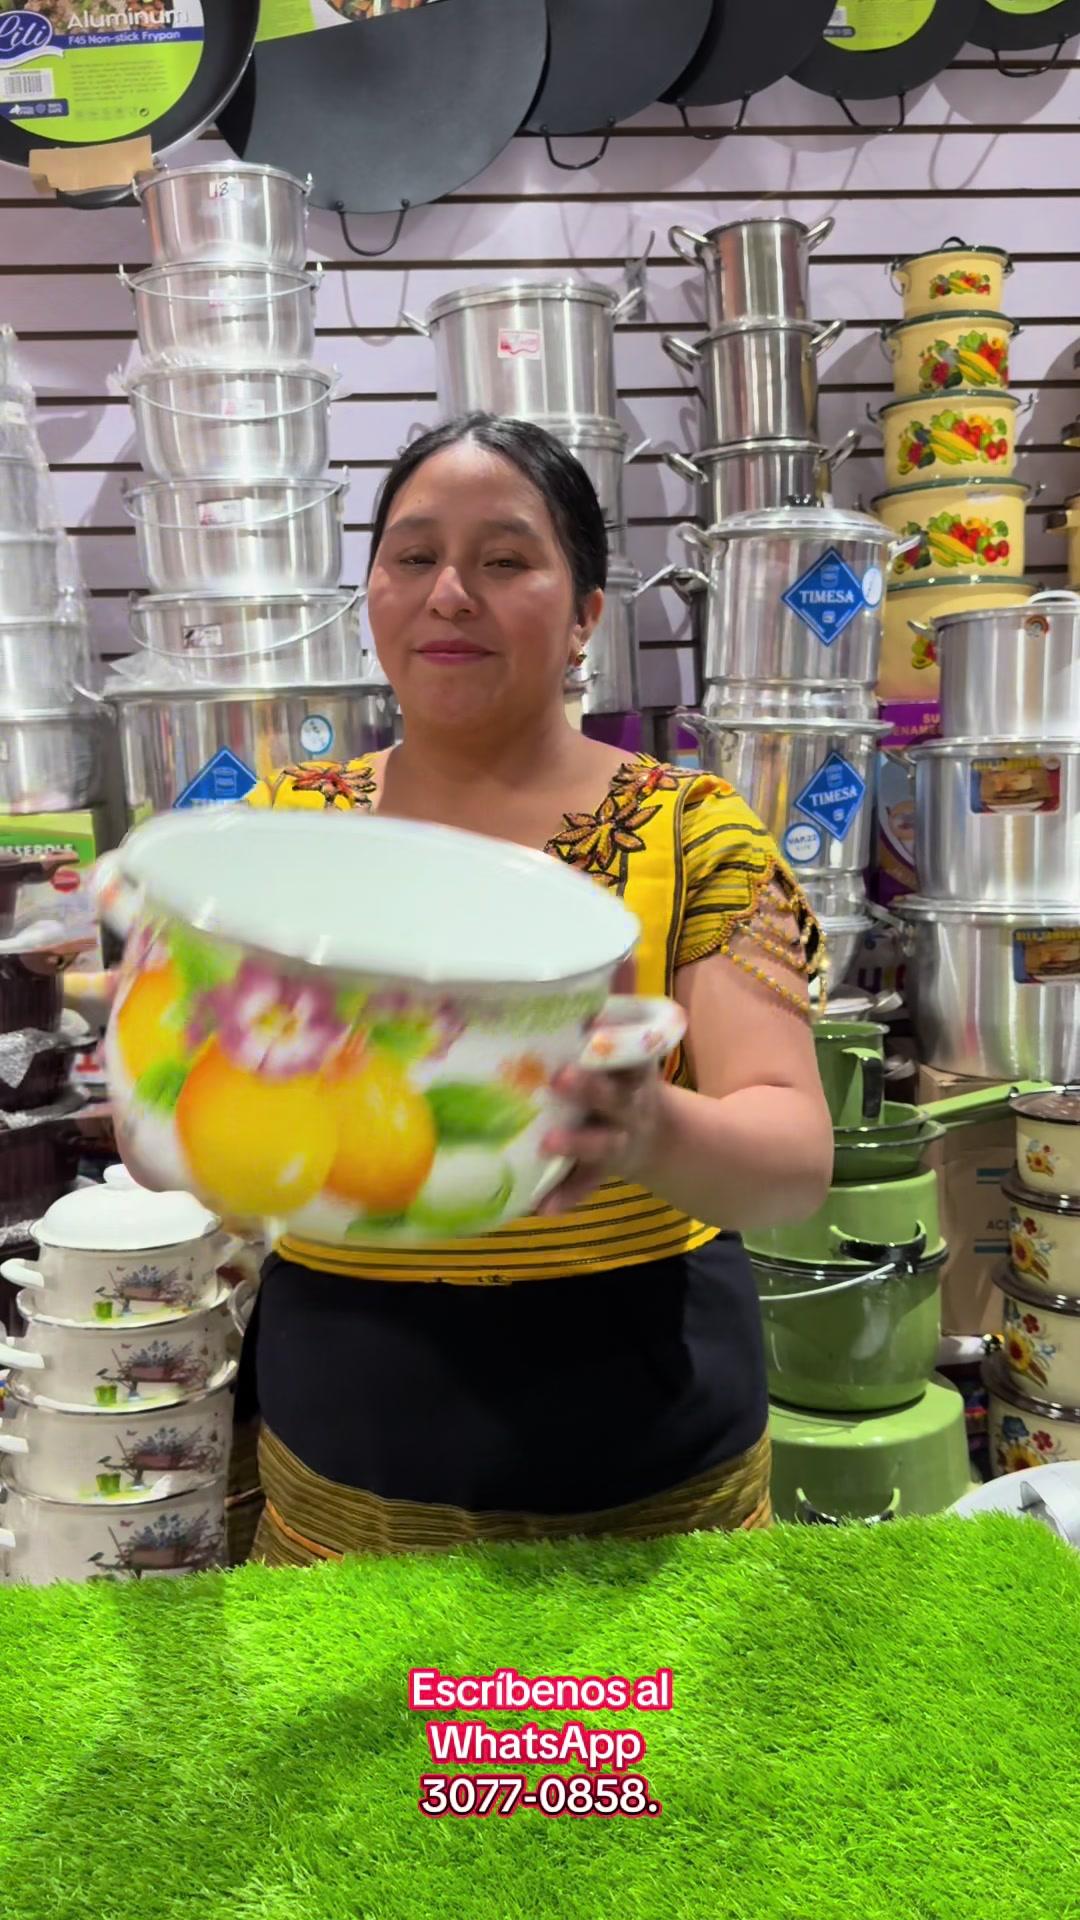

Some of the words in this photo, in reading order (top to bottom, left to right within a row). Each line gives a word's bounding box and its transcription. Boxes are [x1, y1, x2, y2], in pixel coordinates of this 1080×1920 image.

[67, 7, 190, 29] Aluminum
[68, 36, 86, 45] F45
[88, 32, 139, 45] Non-stick
[142, 31, 181, 42] Frypan
[799, 589, 855, 604] TIMESA
[808, 784, 858, 807] TIMESA
